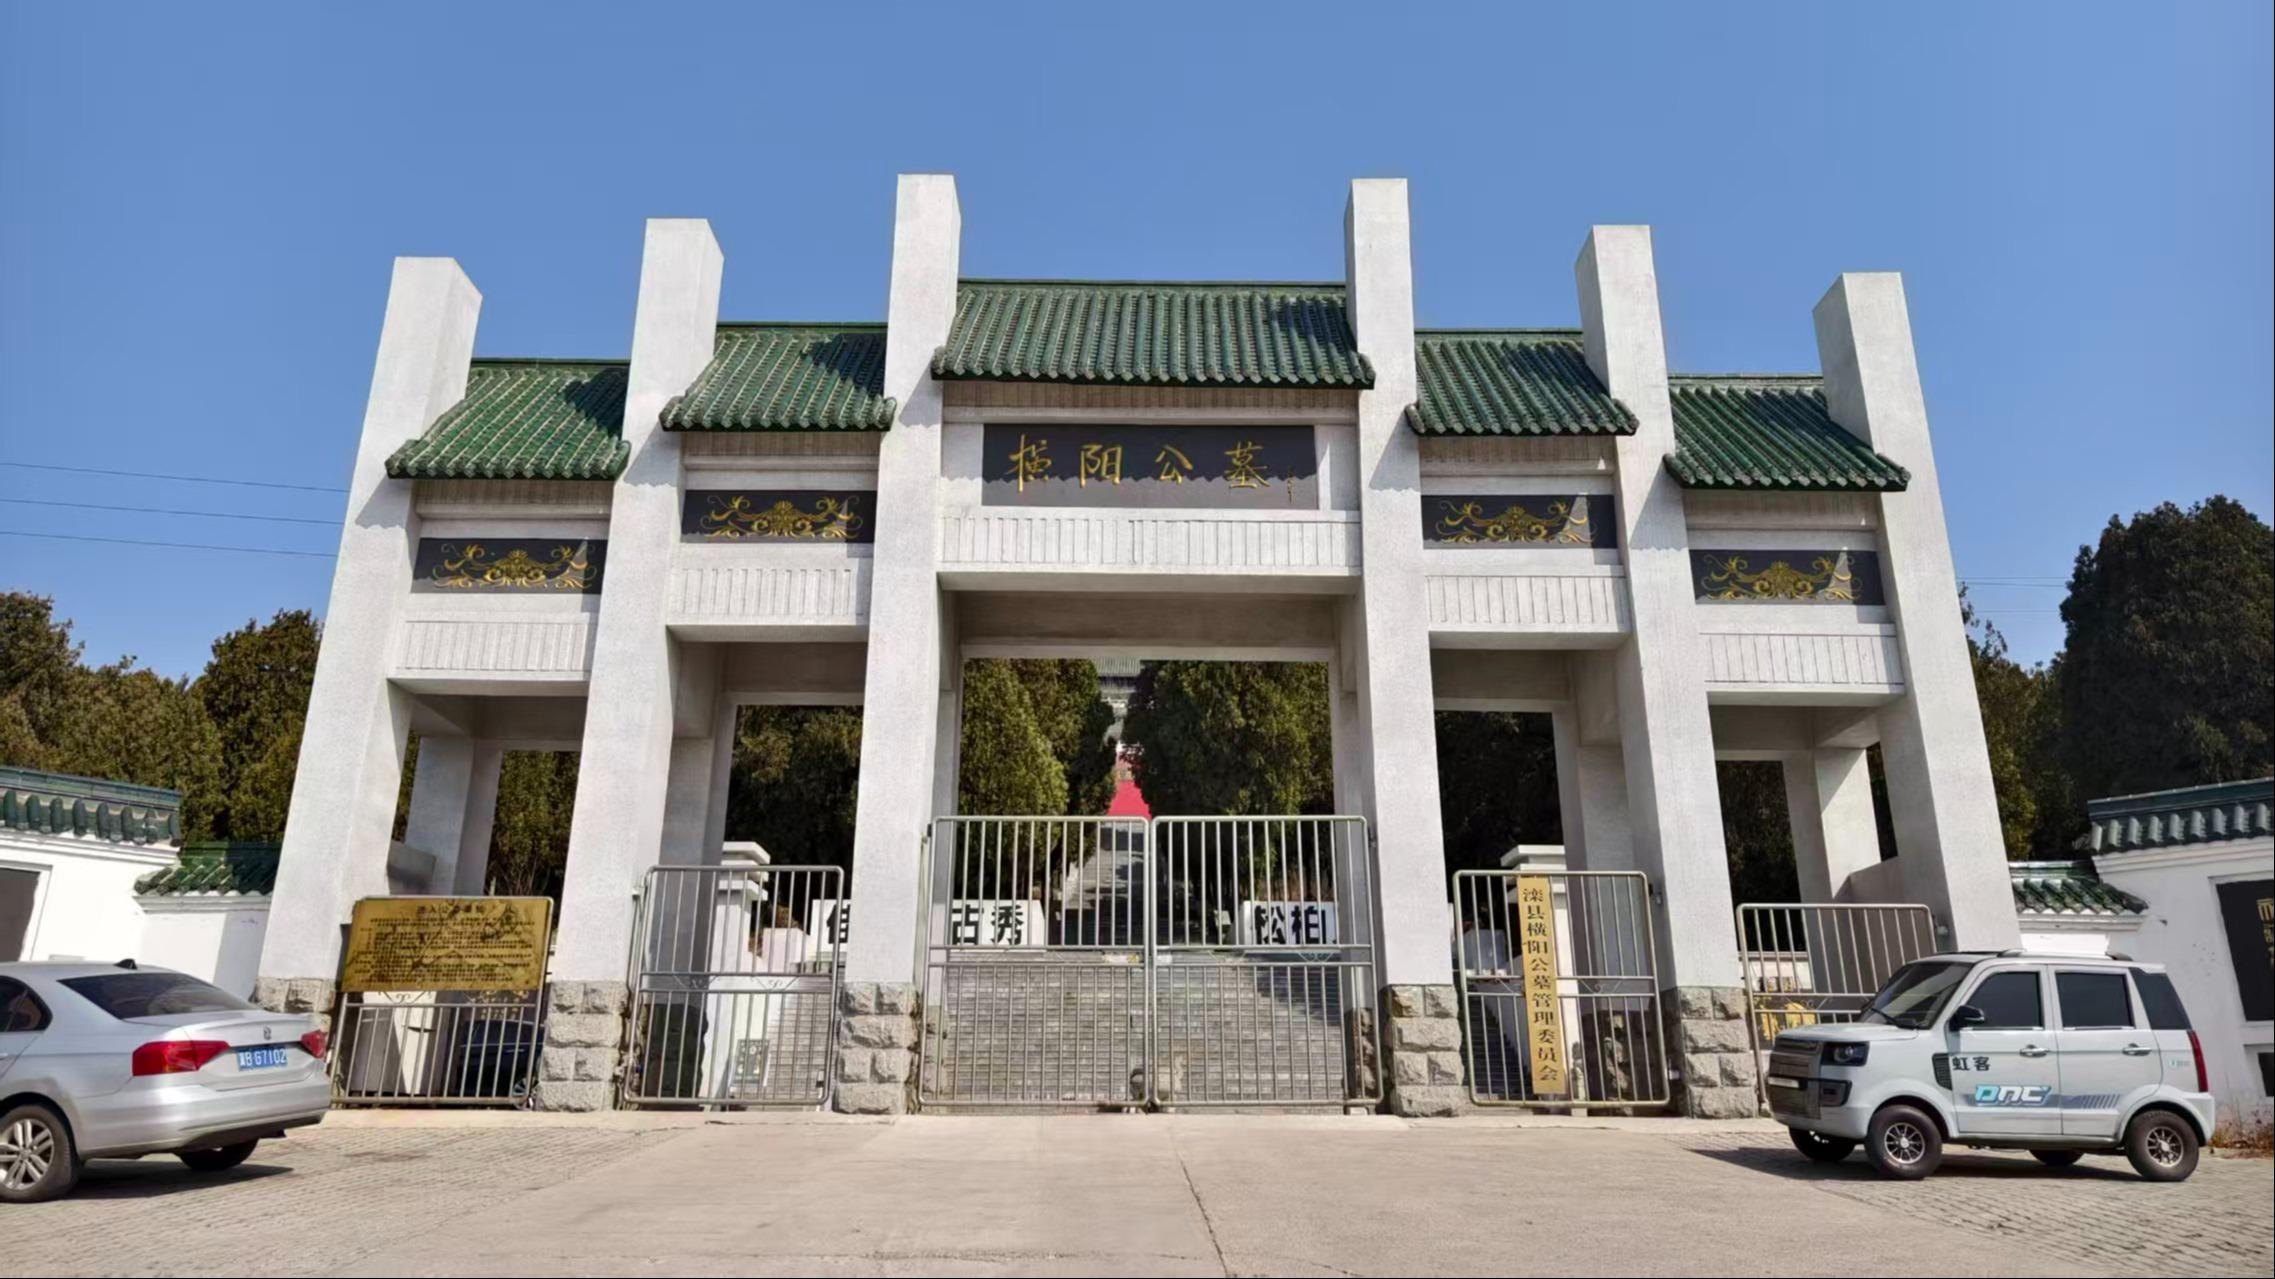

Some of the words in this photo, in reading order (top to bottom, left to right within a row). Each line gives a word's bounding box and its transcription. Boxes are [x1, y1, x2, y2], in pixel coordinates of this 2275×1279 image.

[1006, 434, 1270, 493] 横阳公墓
[1522, 888, 1559, 1081] 滦县横阳公墓管理委员会
[1952, 1056, 1991, 1071] 虹客
